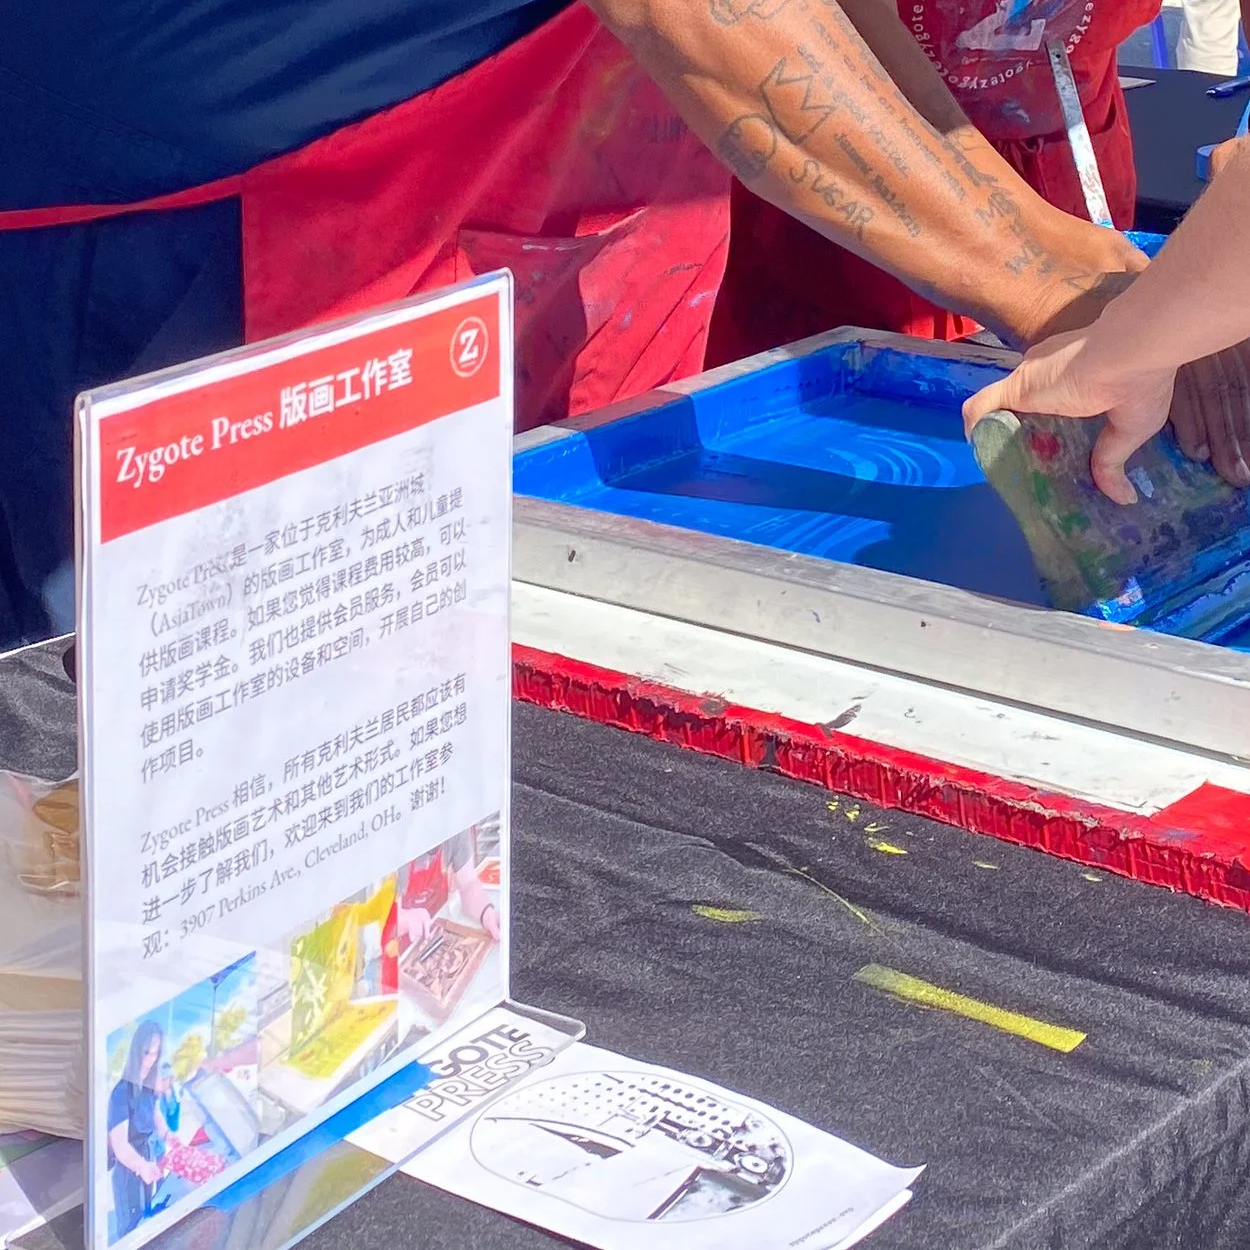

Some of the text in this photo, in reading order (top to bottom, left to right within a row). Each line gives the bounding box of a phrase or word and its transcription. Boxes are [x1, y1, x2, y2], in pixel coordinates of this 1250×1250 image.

[115, 348, 414, 490] Zygote Press 版画工作室
[136, 573, 191, 609] Zygote
[140, 738, 204, 785] 作项目。
[140, 819, 192, 855] Zygote
[195, 800, 230, 828] Press
[179, 906, 216, 940] 3907
[217, 879, 267, 921] Perkins
[304, 829, 369, 871] Cleveland,
[402, 1039, 556, 1122] PRESS
